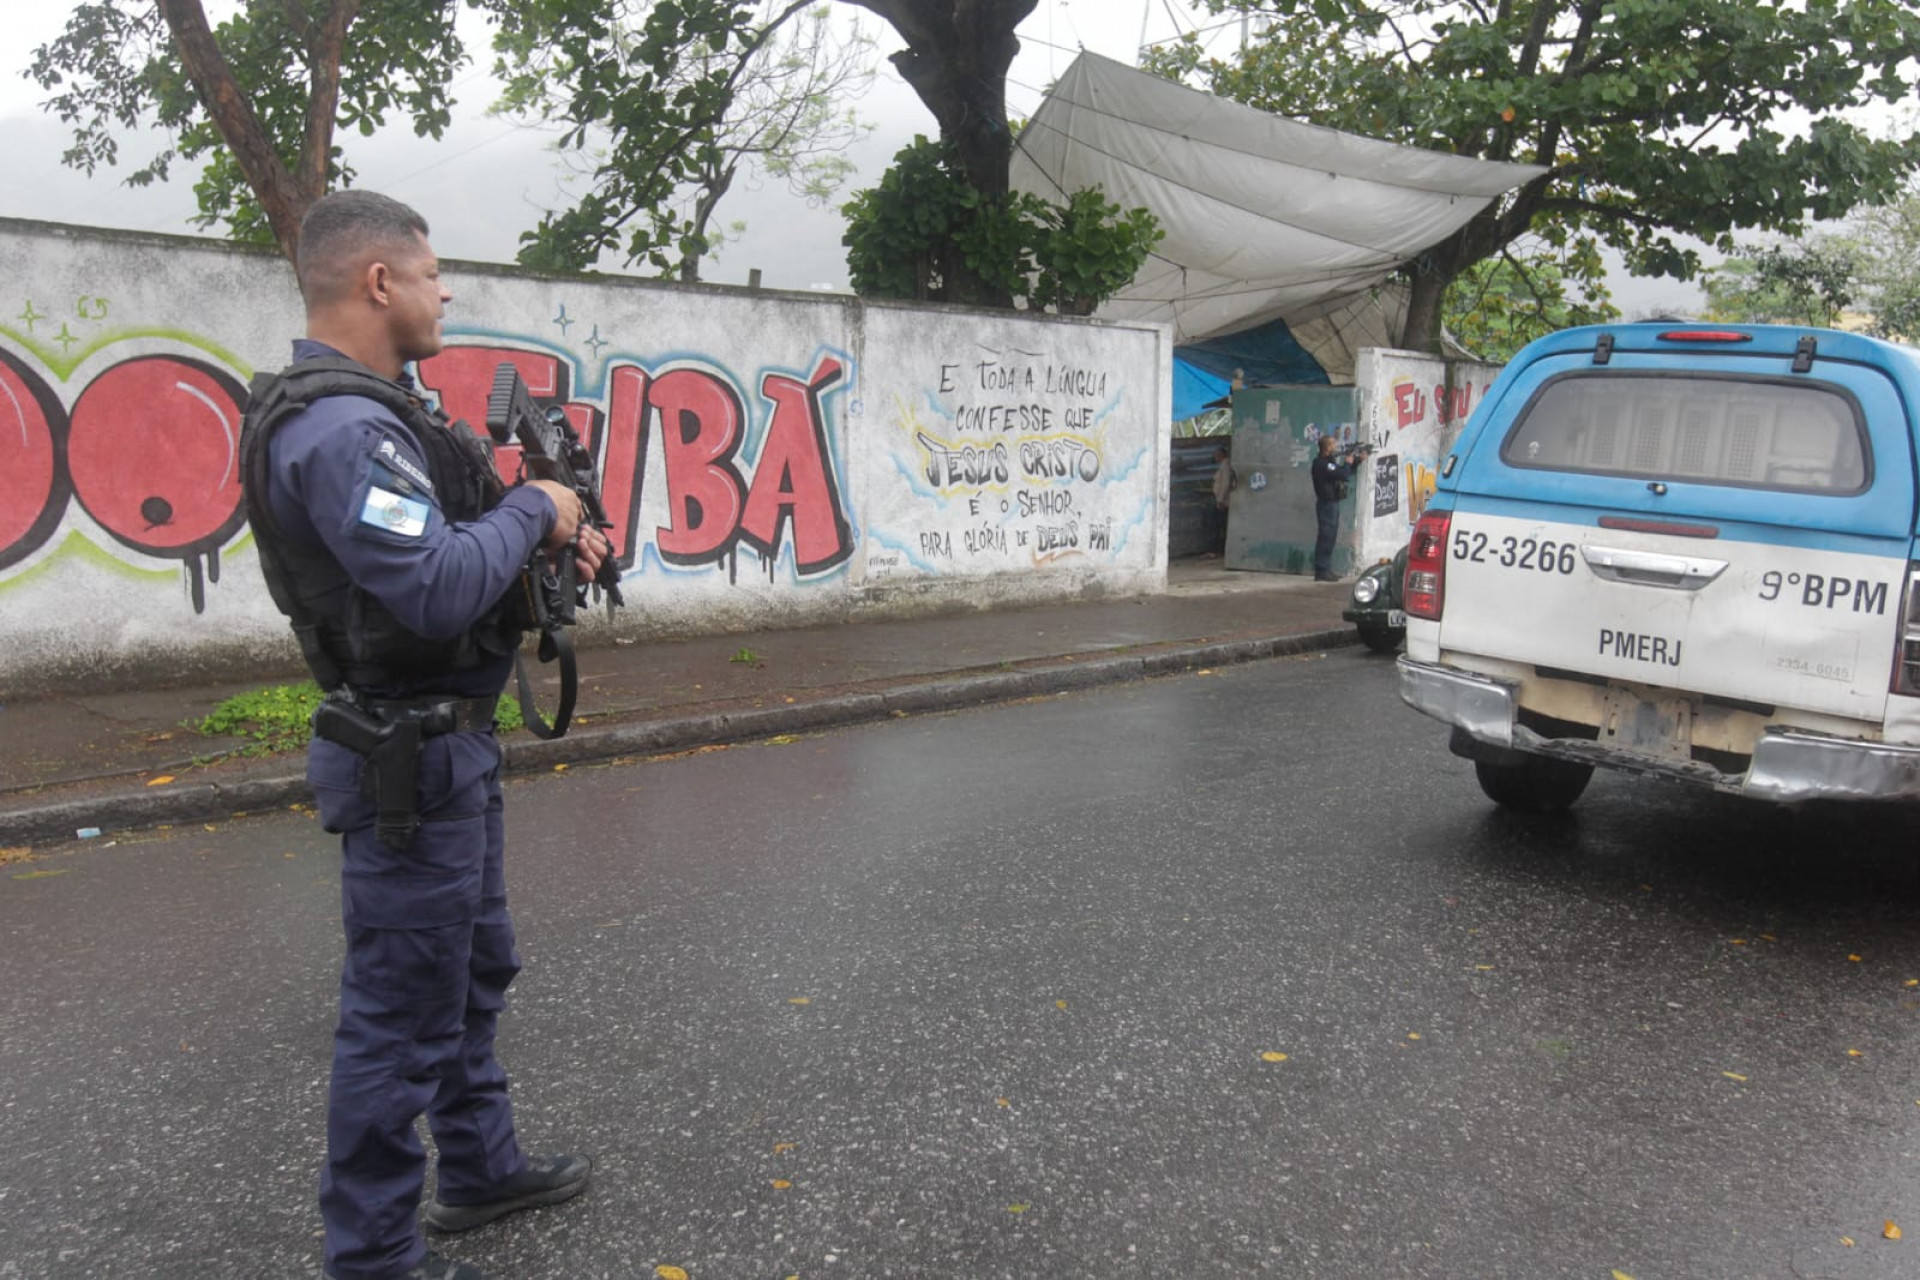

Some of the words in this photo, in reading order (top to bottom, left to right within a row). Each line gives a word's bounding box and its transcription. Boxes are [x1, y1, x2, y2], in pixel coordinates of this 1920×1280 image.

[939, 364, 960, 393] E
[1025, 367, 1034, 393] A
[1046, 365, 1106, 398] LÍNGUA
[956, 404, 1053, 432] CONFESSE
[1065, 408, 1094, 431] QUE
[1394, 383, 1426, 430] EU
[917, 431, 1009, 487] JESUS
[1019, 437, 1100, 483] CRISTO
[969, 491, 982, 516] É
[919, 530, 953, 560] PARA
[964, 520, 1008, 556] GLÓRIA
[1015, 529, 1029, 548] DE
[1036, 519, 1079, 553] DEUS
[1453, 529, 1577, 575] 52-3266
[1599, 628, 1682, 667] PMERJ
